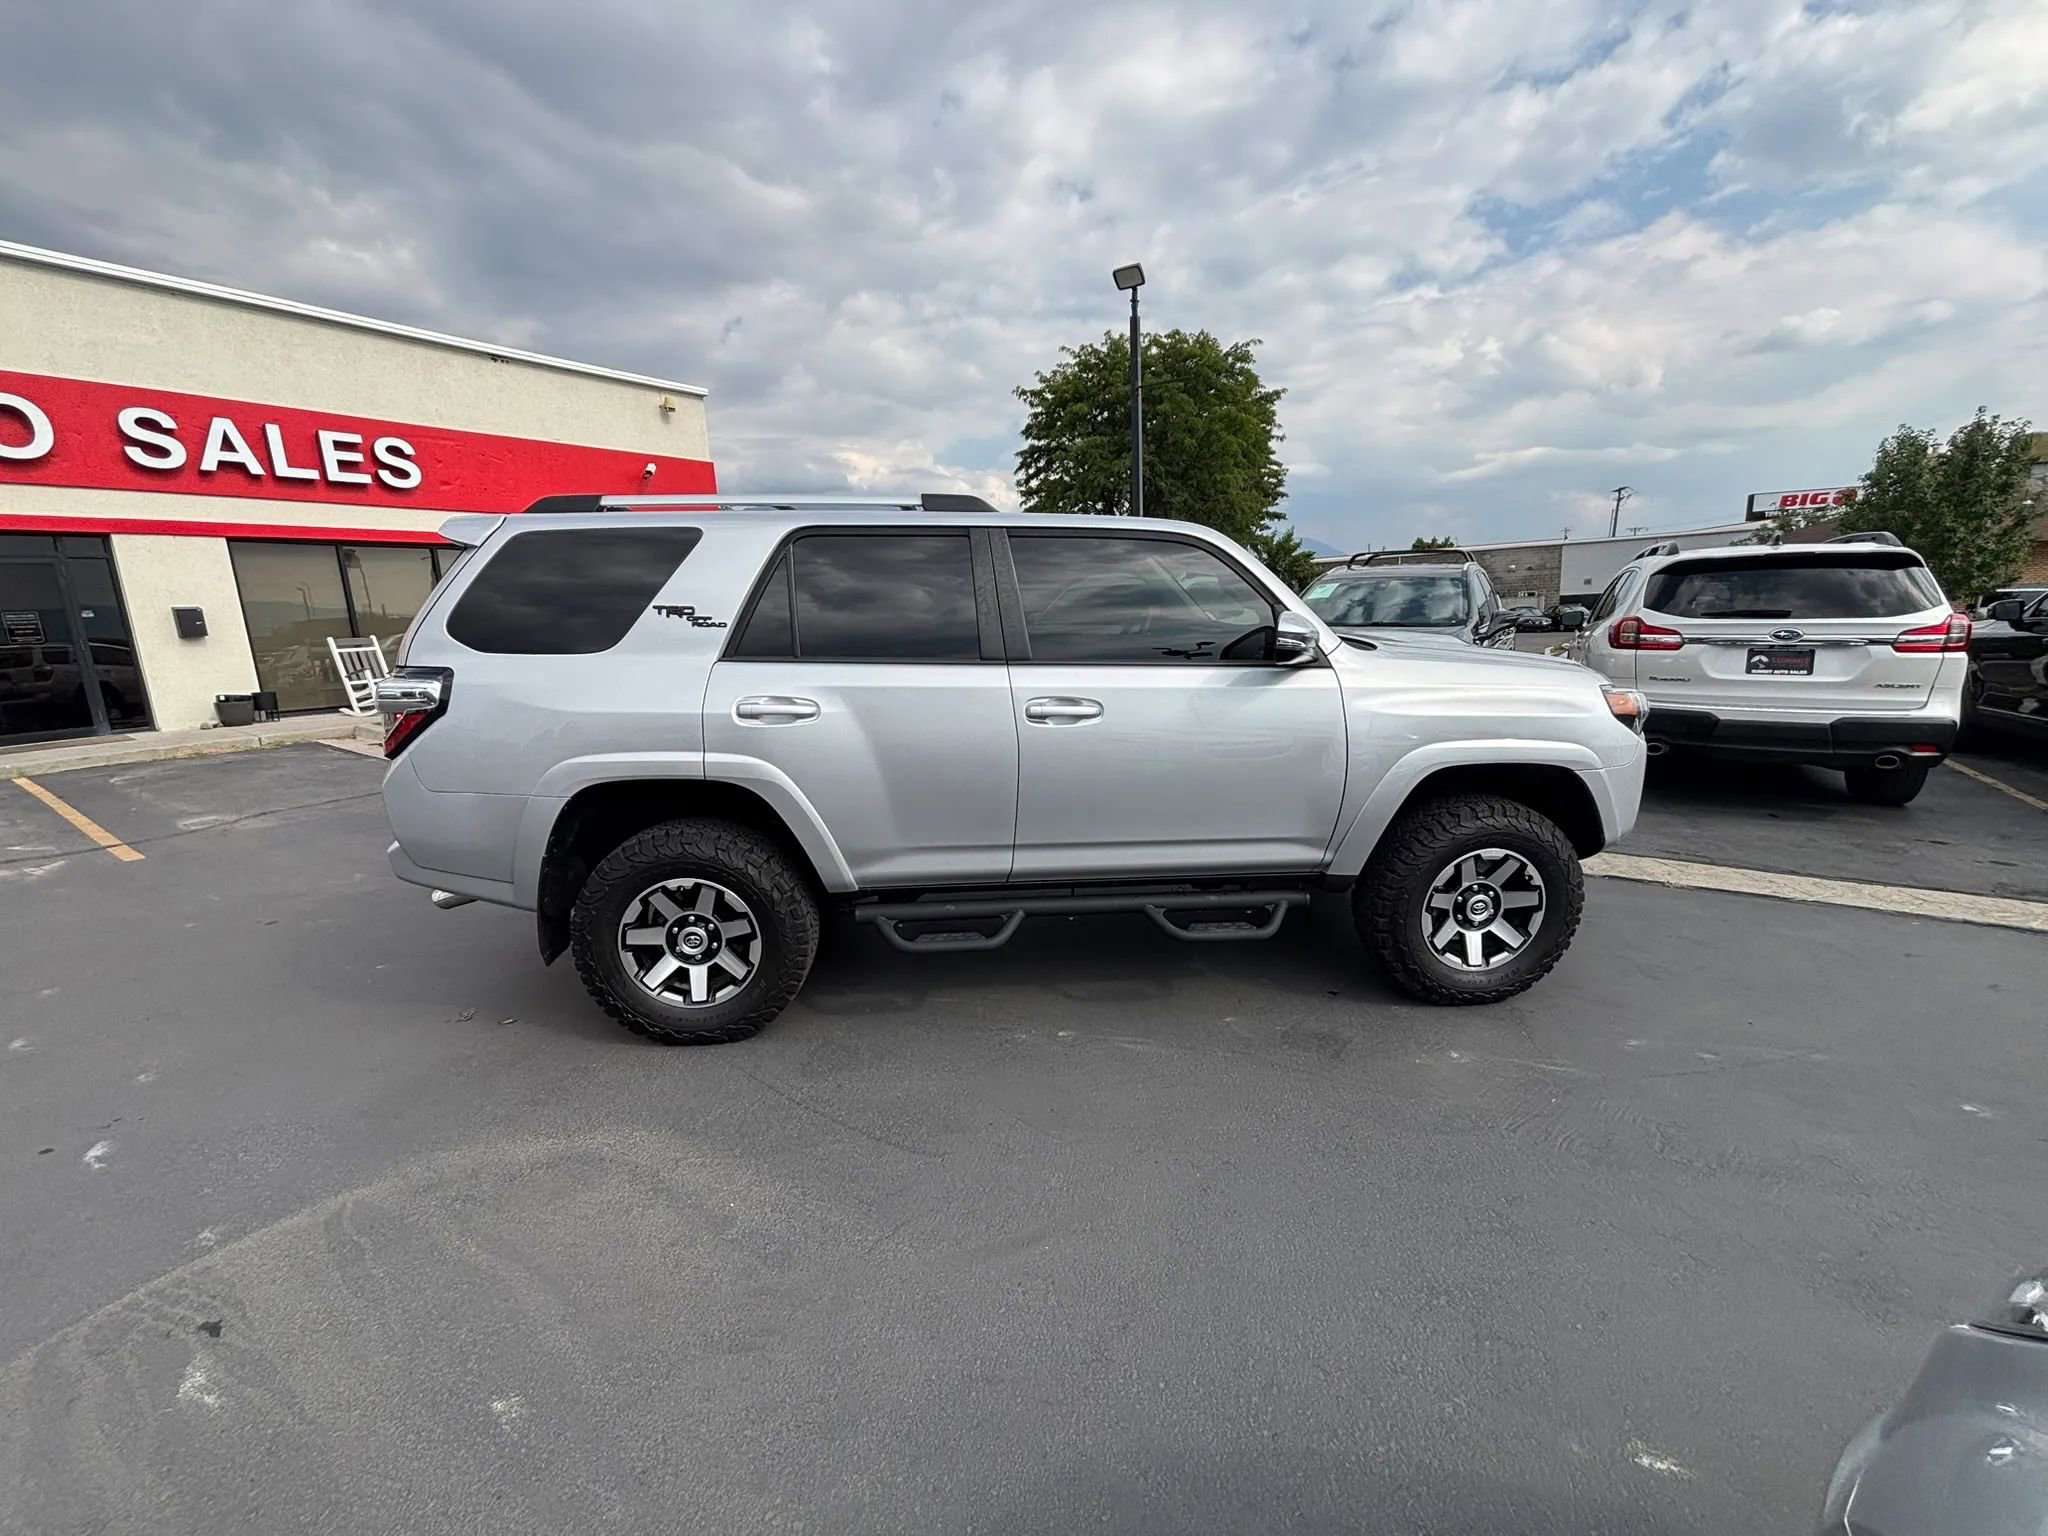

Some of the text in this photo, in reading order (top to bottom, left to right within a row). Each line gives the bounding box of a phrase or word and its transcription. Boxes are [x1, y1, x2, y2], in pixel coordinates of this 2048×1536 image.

[117, 406, 423, 489] SALES
[1779, 492, 1830, 508] BIG
[652, 605, 695, 619] TRD
